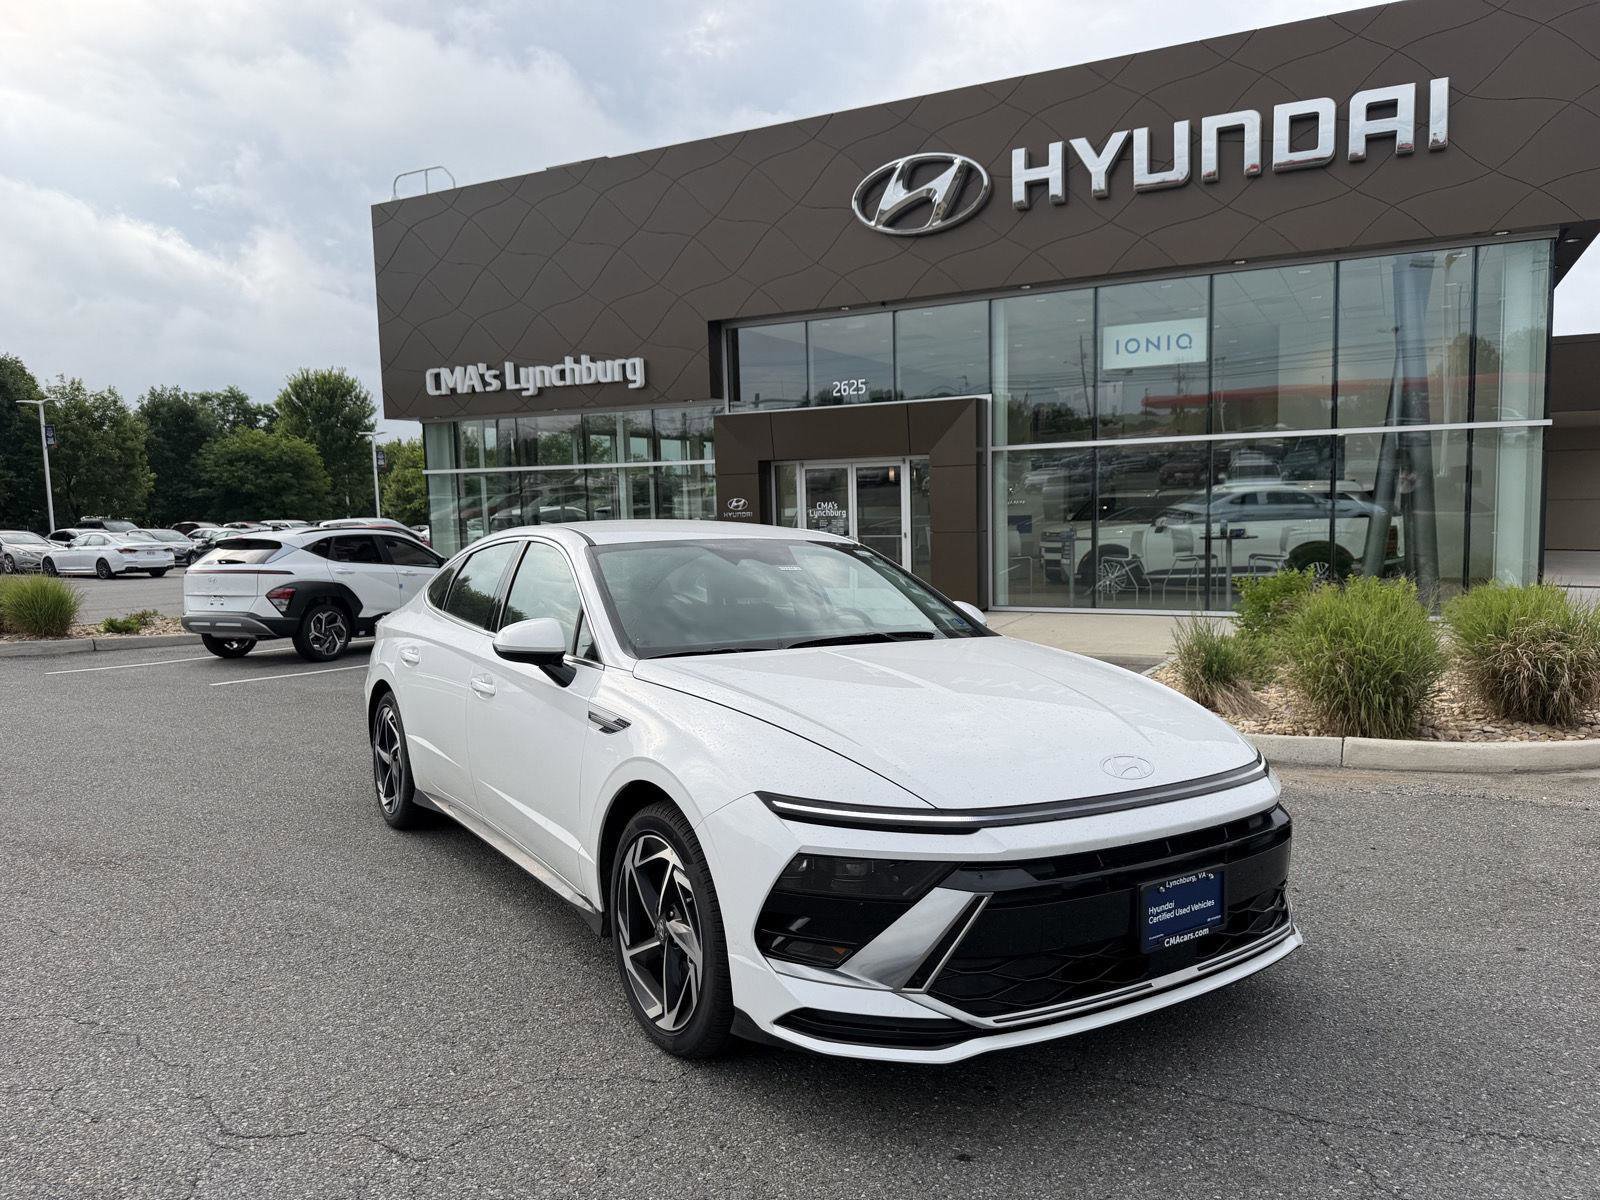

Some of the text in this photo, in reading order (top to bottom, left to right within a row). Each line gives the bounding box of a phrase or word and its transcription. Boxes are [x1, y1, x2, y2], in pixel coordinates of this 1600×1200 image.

[1011, 77, 1450, 211] HYUNDAI
[1115, 332, 1193, 355] IONIQ
[425, 354, 646, 397] CMA's Lynchburg
[832, 378, 866, 397] 2625
[809, 509, 847, 519] Lynchburg
[816, 501, 839, 511] CMA's
[1148, 900, 1175, 915] Hyundai
[1148, 899, 1215, 925] Certified Used Vehicles
[1164, 927, 1210, 947] CMAcars.com
